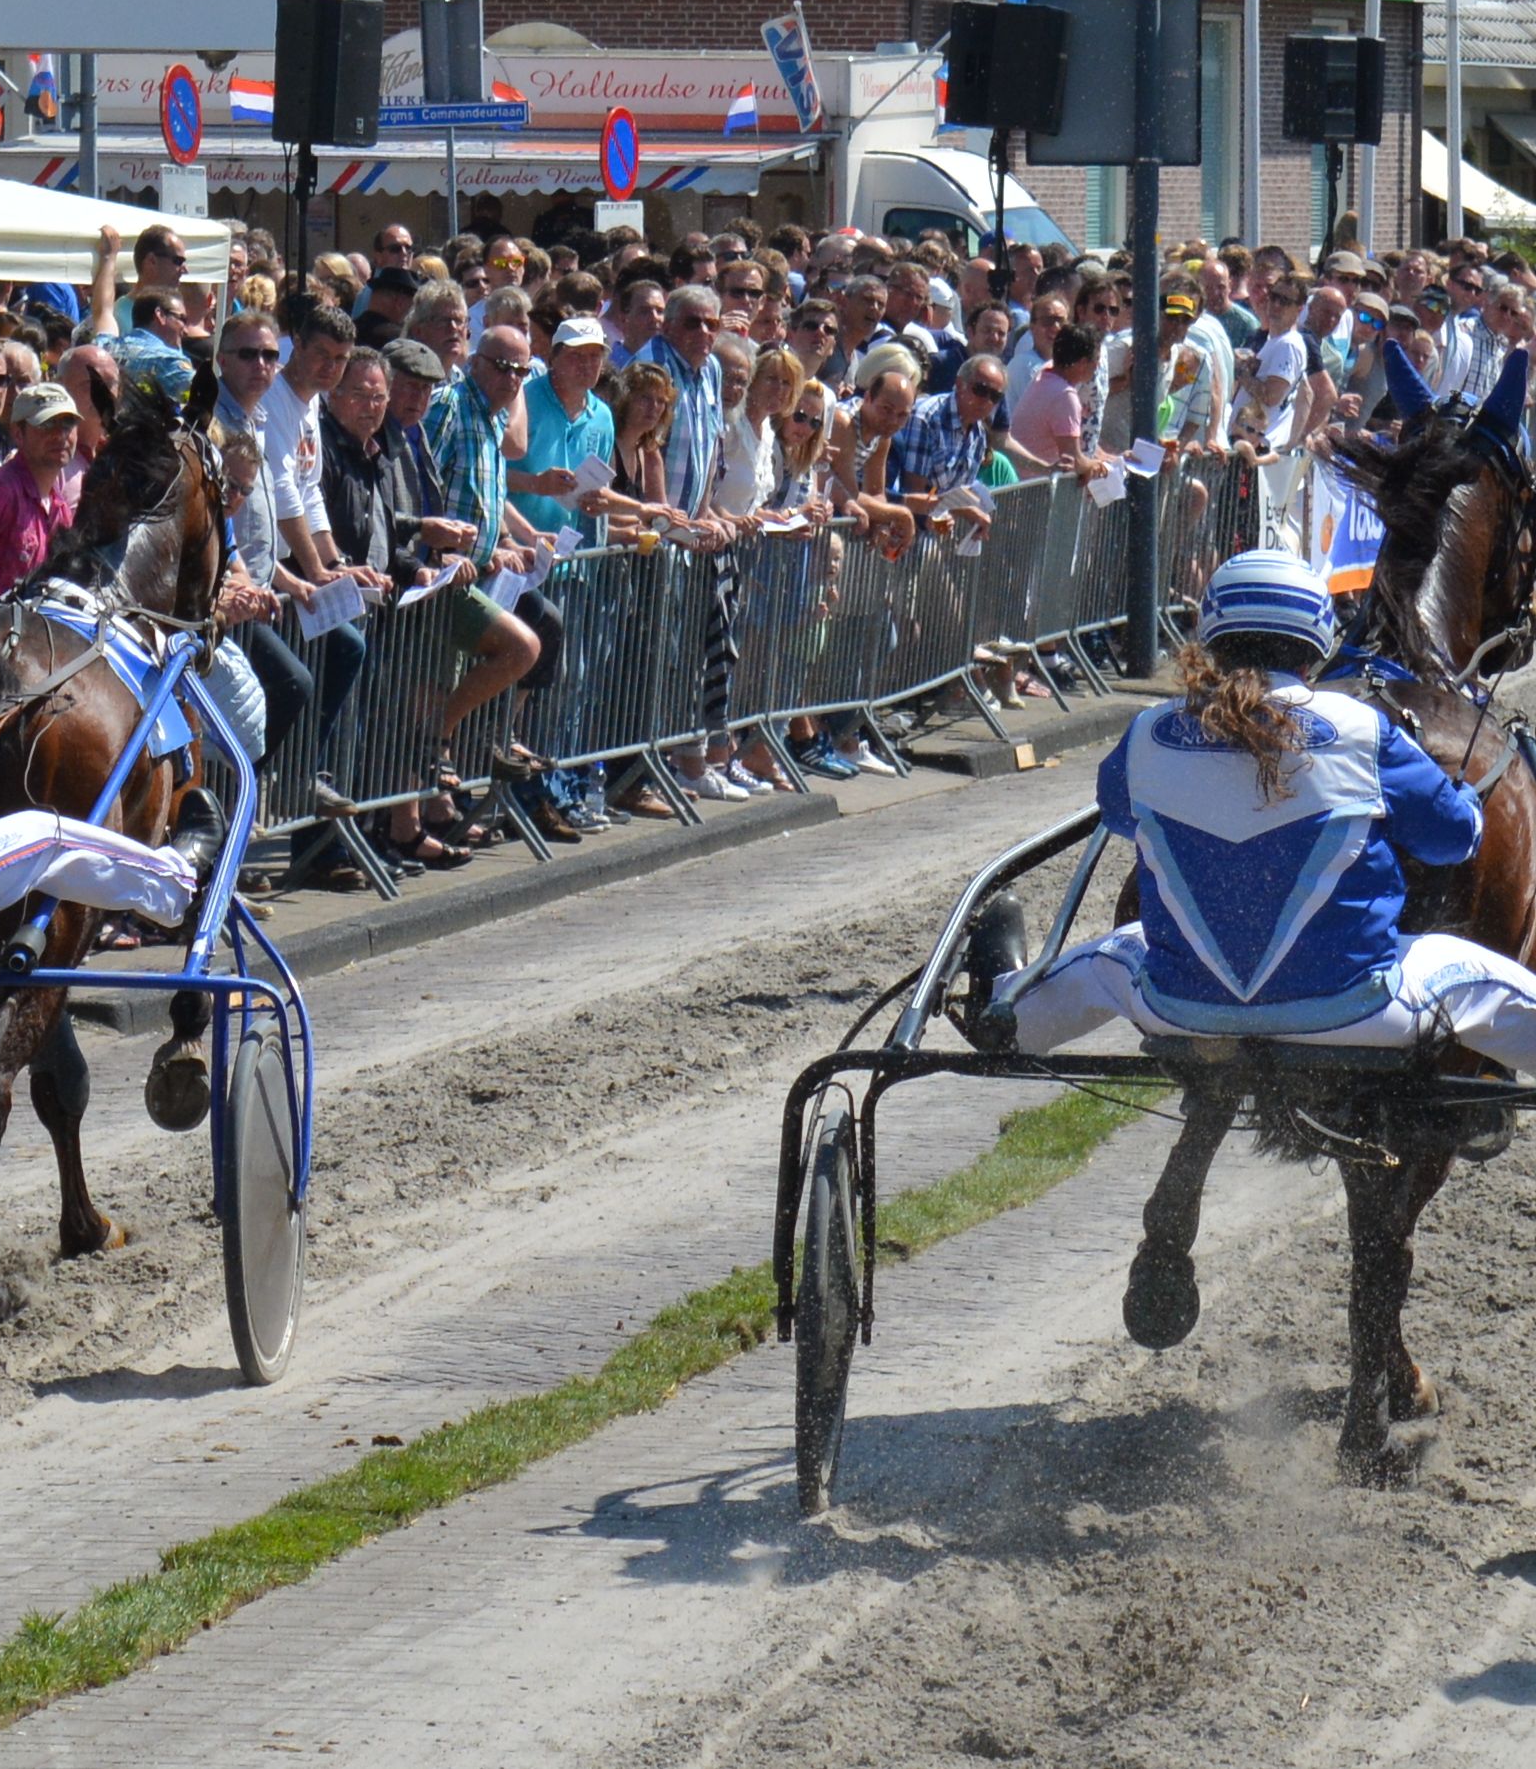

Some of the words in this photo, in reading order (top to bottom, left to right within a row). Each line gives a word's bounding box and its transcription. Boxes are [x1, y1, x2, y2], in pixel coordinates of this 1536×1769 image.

[530, 68, 701, 100] Hollandse
[774, 28, 814, 118] VIS
[421, 105, 524, 120] Commandeurlaan
[440, 166, 539, 185] Hollandse
